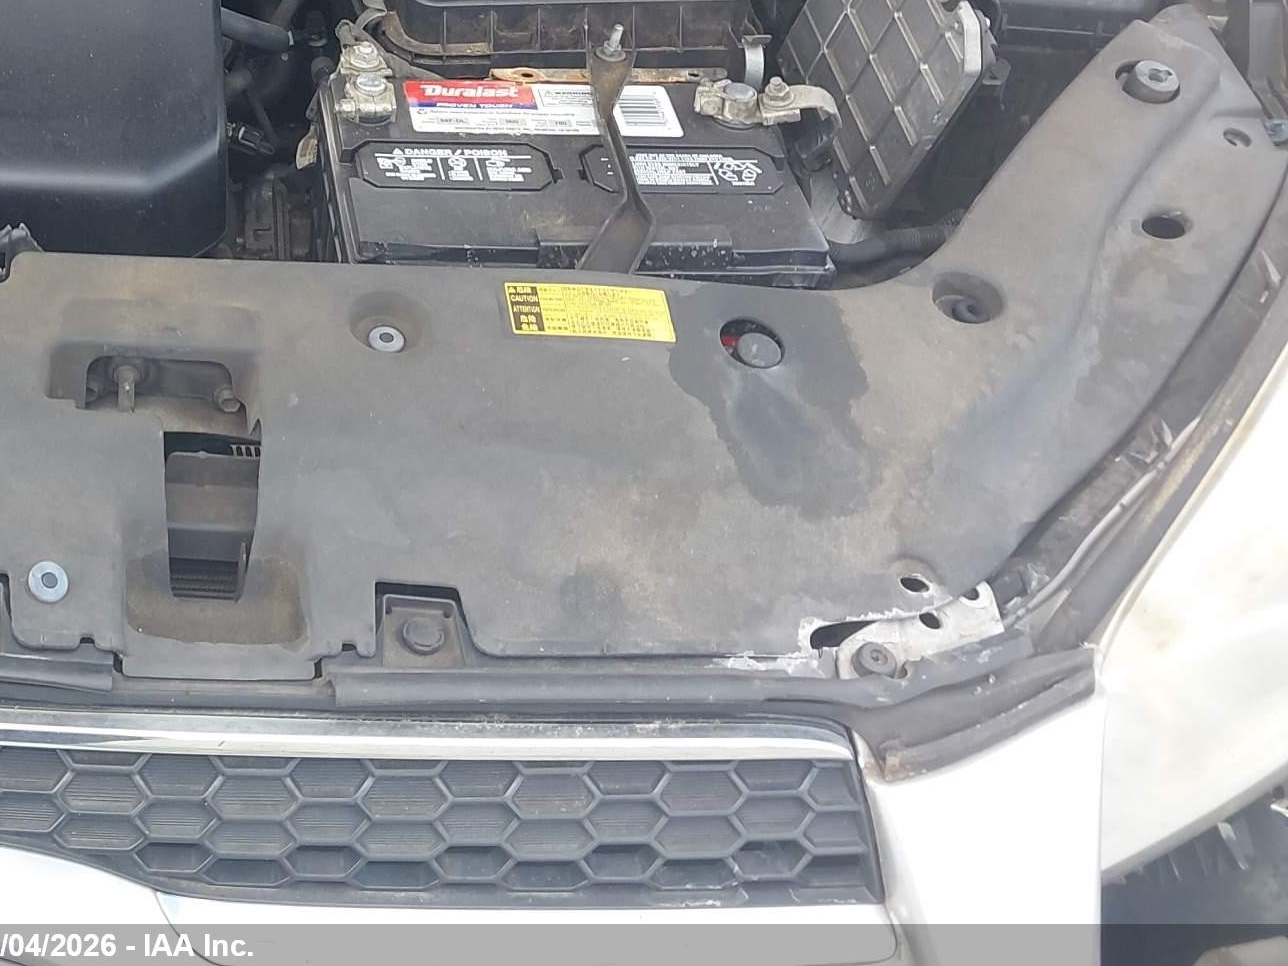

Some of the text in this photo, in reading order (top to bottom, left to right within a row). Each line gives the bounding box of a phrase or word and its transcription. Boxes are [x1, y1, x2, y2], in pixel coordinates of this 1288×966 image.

[420, 84, 519, 98] Duralast
[404, 148, 452, 156] DANGER
[510, 294, 539, 303] CAUTION
[513, 305, 541, 313] ATTENTION
